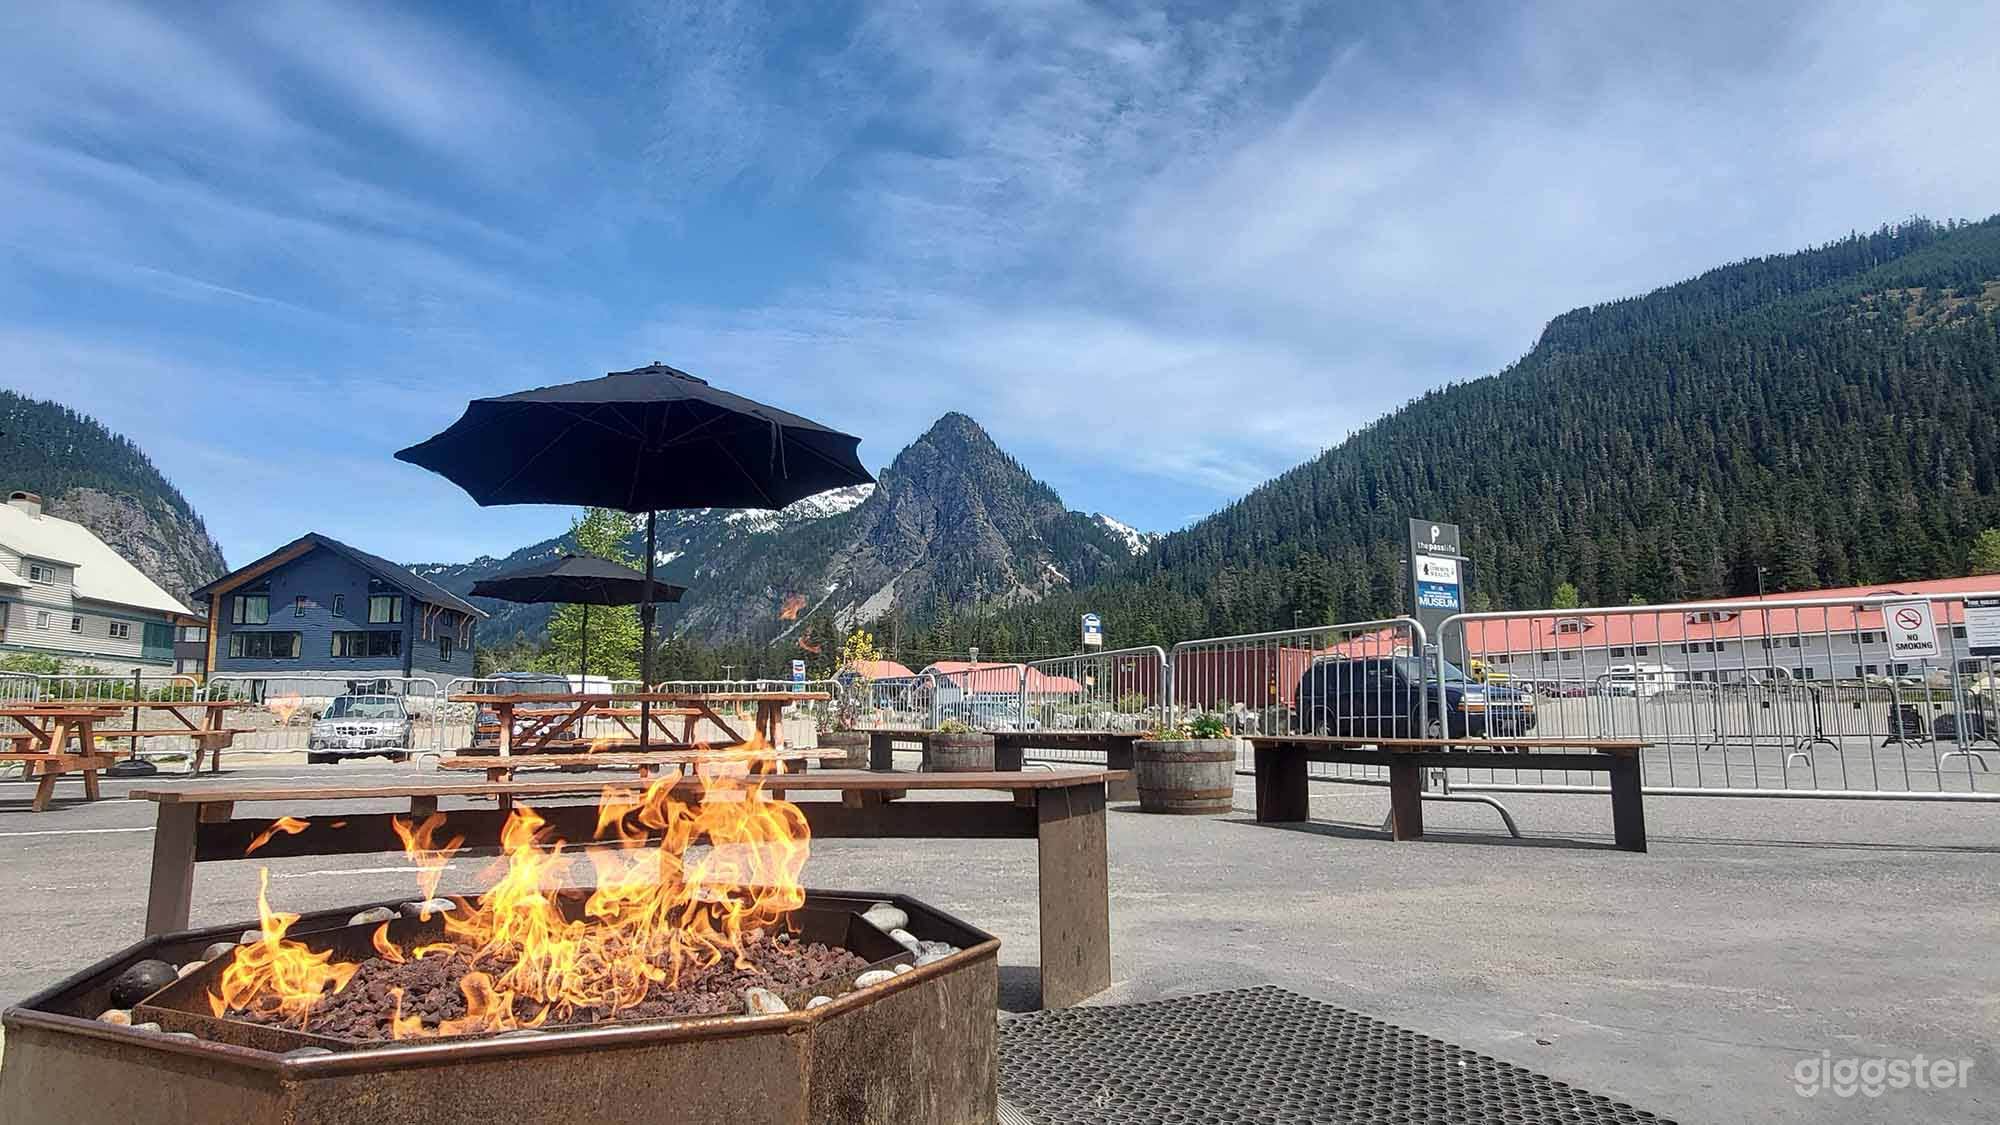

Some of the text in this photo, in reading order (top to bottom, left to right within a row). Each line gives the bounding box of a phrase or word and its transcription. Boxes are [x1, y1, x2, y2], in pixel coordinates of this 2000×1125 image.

[1418, 596, 1458, 608] MUSEUM
[1906, 633, 1918, 641] NO
[1895, 641, 1933, 651] SMOKING
